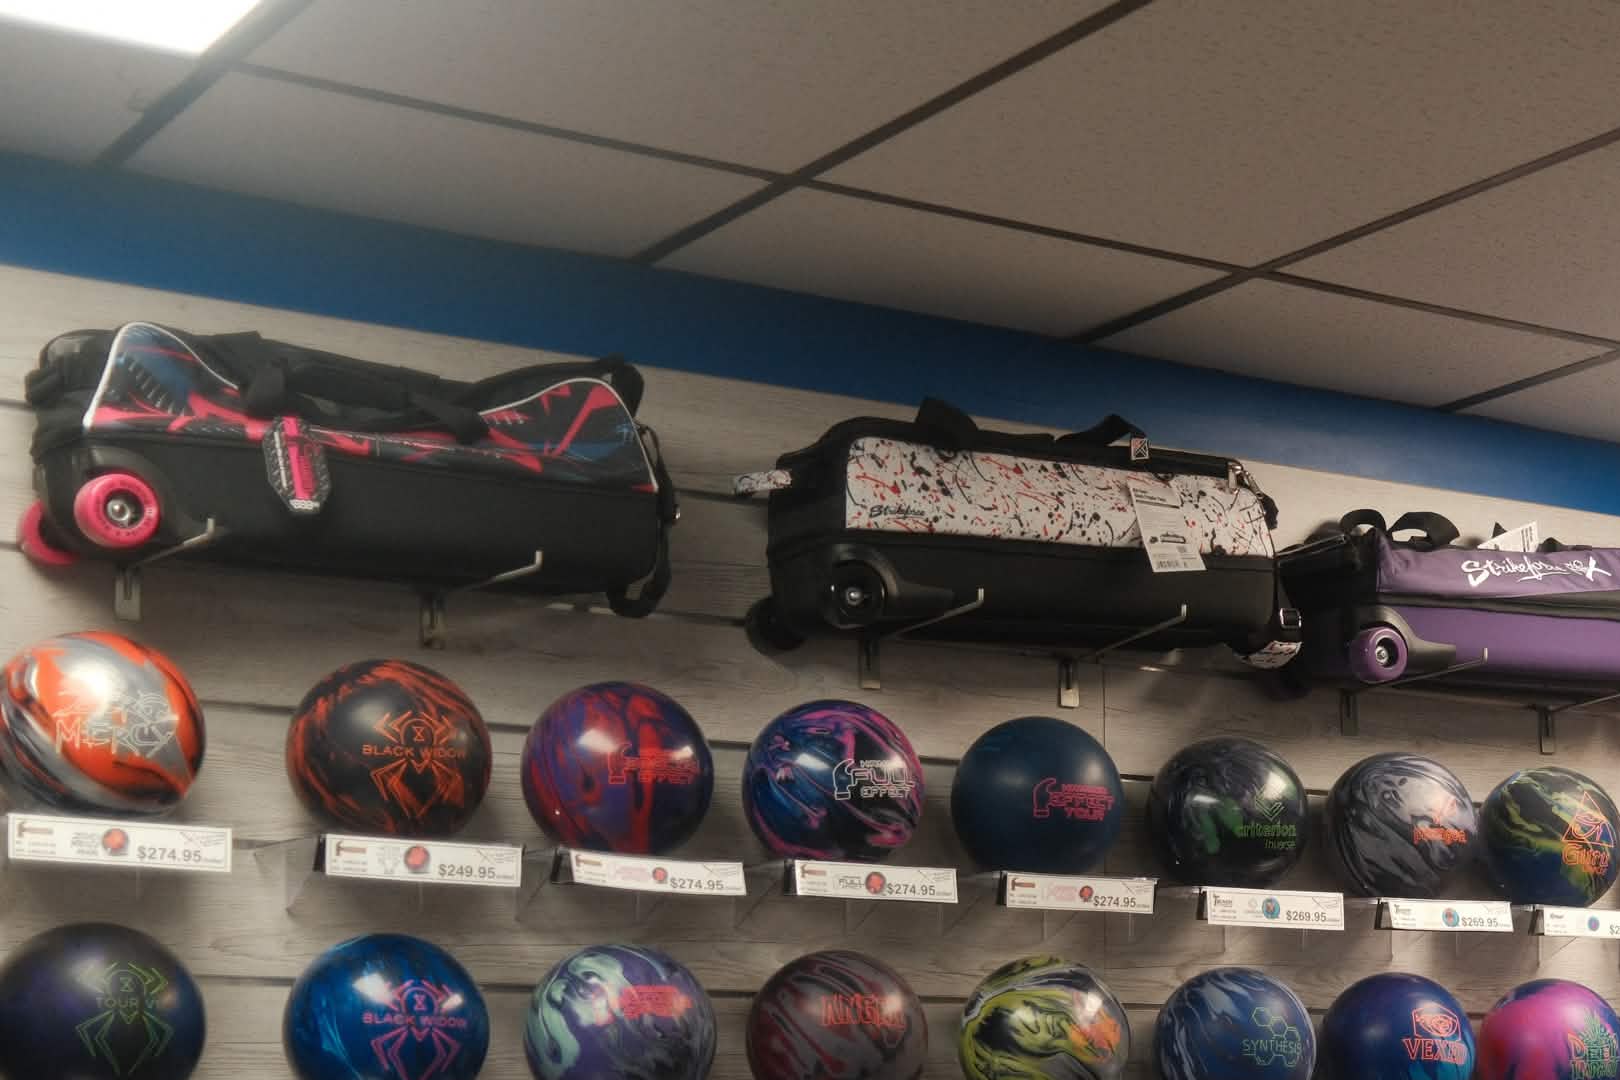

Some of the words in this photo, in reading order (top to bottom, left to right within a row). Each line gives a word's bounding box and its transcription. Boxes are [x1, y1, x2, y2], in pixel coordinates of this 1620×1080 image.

[362, 744, 414, 757] BLACK
[420, 746, 466, 758] WIDOW
[851, 768, 915, 788] FULL
[438, 863, 496, 879] $249.95
[886, 883, 936, 896] $274.95
[1093, 895, 1137, 908] $274.95
[1285, 910, 1327, 922] $269.95
[363, 1012, 416, 1026] BLACK
[1242, 1039, 1303, 1055] SYNTHESIS
